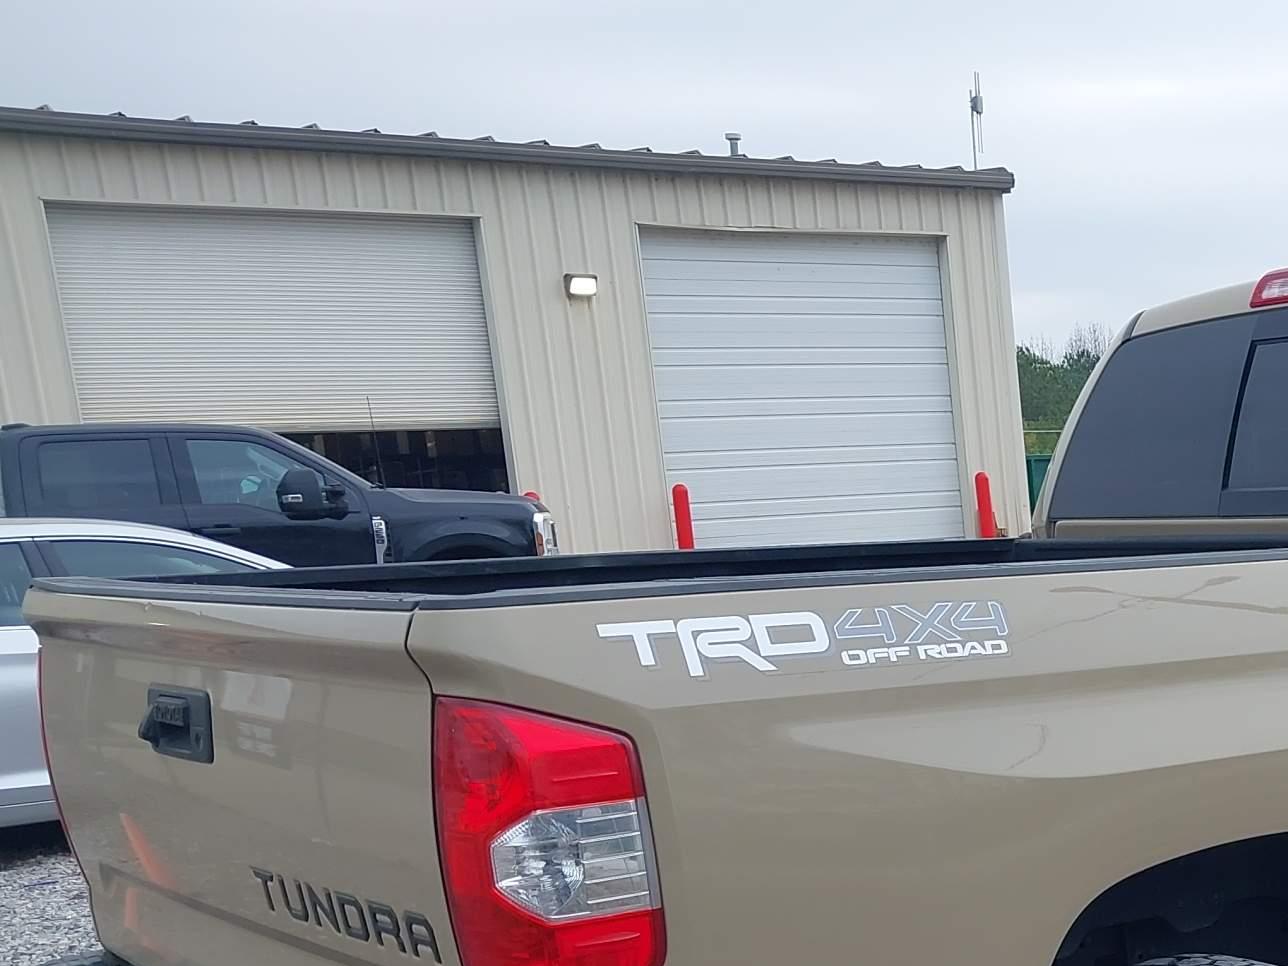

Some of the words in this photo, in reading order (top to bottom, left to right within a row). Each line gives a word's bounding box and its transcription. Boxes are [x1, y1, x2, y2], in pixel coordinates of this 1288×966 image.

[596, 611, 830, 676] TRD
[834, 601, 1008, 643] 4X4
[841, 646, 910, 665] OFF
[917, 640, 1008, 659] ROAD
[250, 866, 443, 966] TUNDRA
